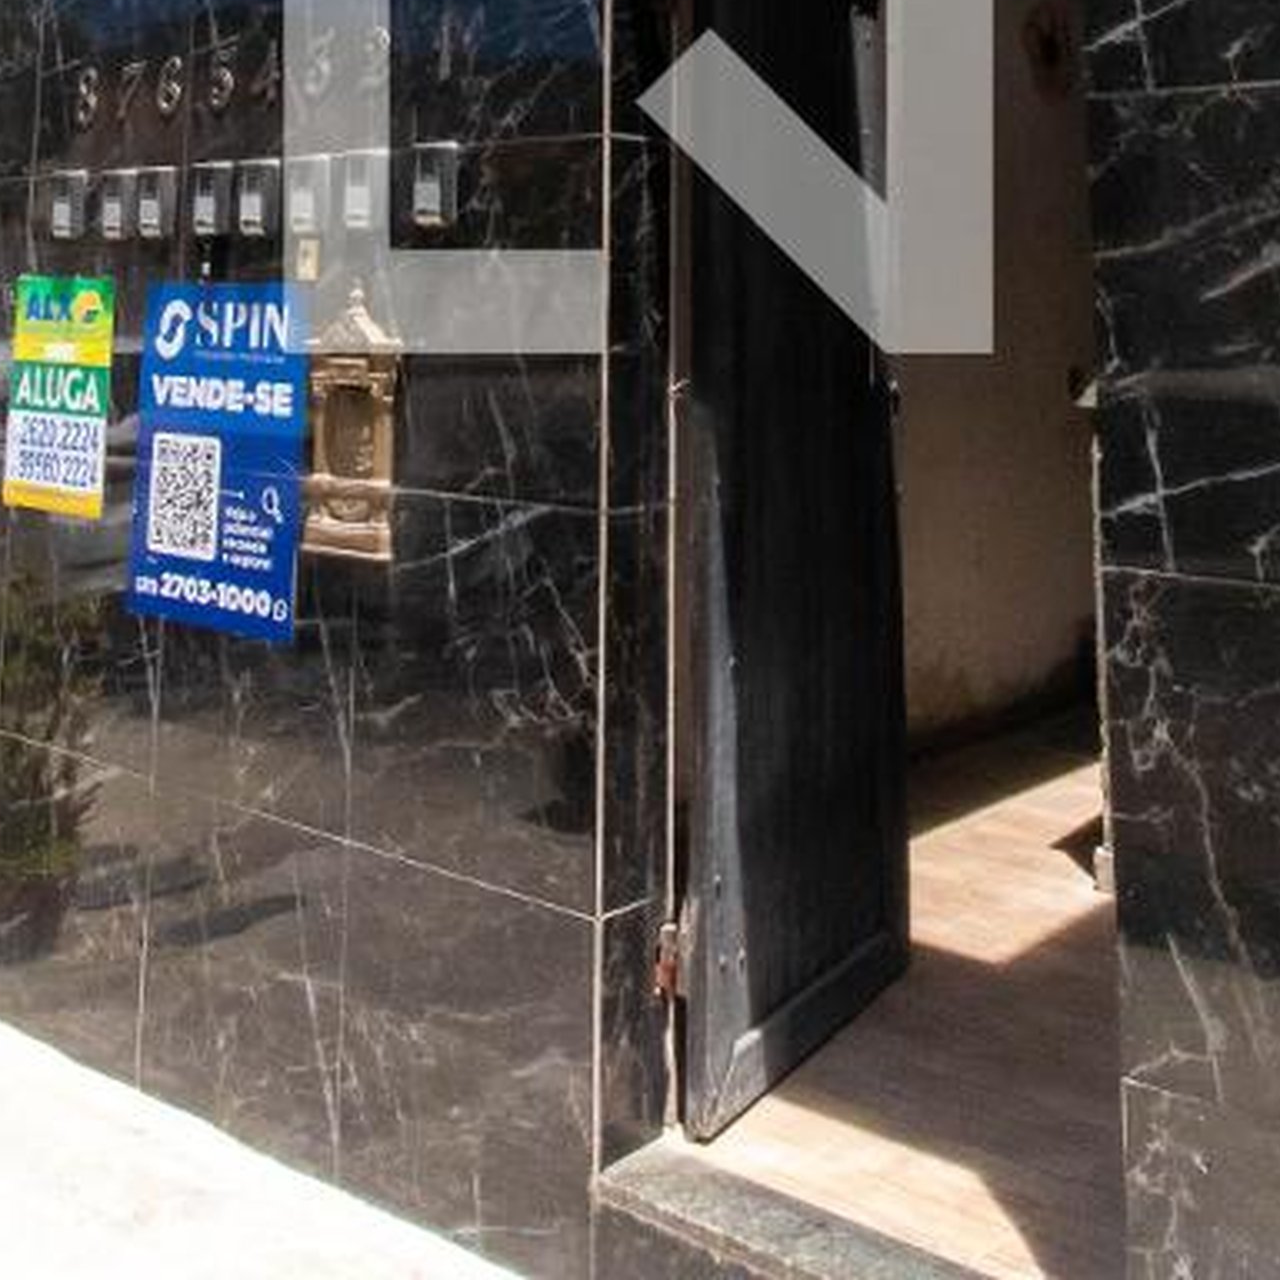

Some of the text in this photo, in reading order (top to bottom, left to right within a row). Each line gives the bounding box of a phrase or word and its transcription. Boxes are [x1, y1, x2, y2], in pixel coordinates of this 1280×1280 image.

[194, 299, 290, 350] SPIN
[15, 368, 101, 414] ALUGA
[152, 374, 294, 418] VENDE-SE
